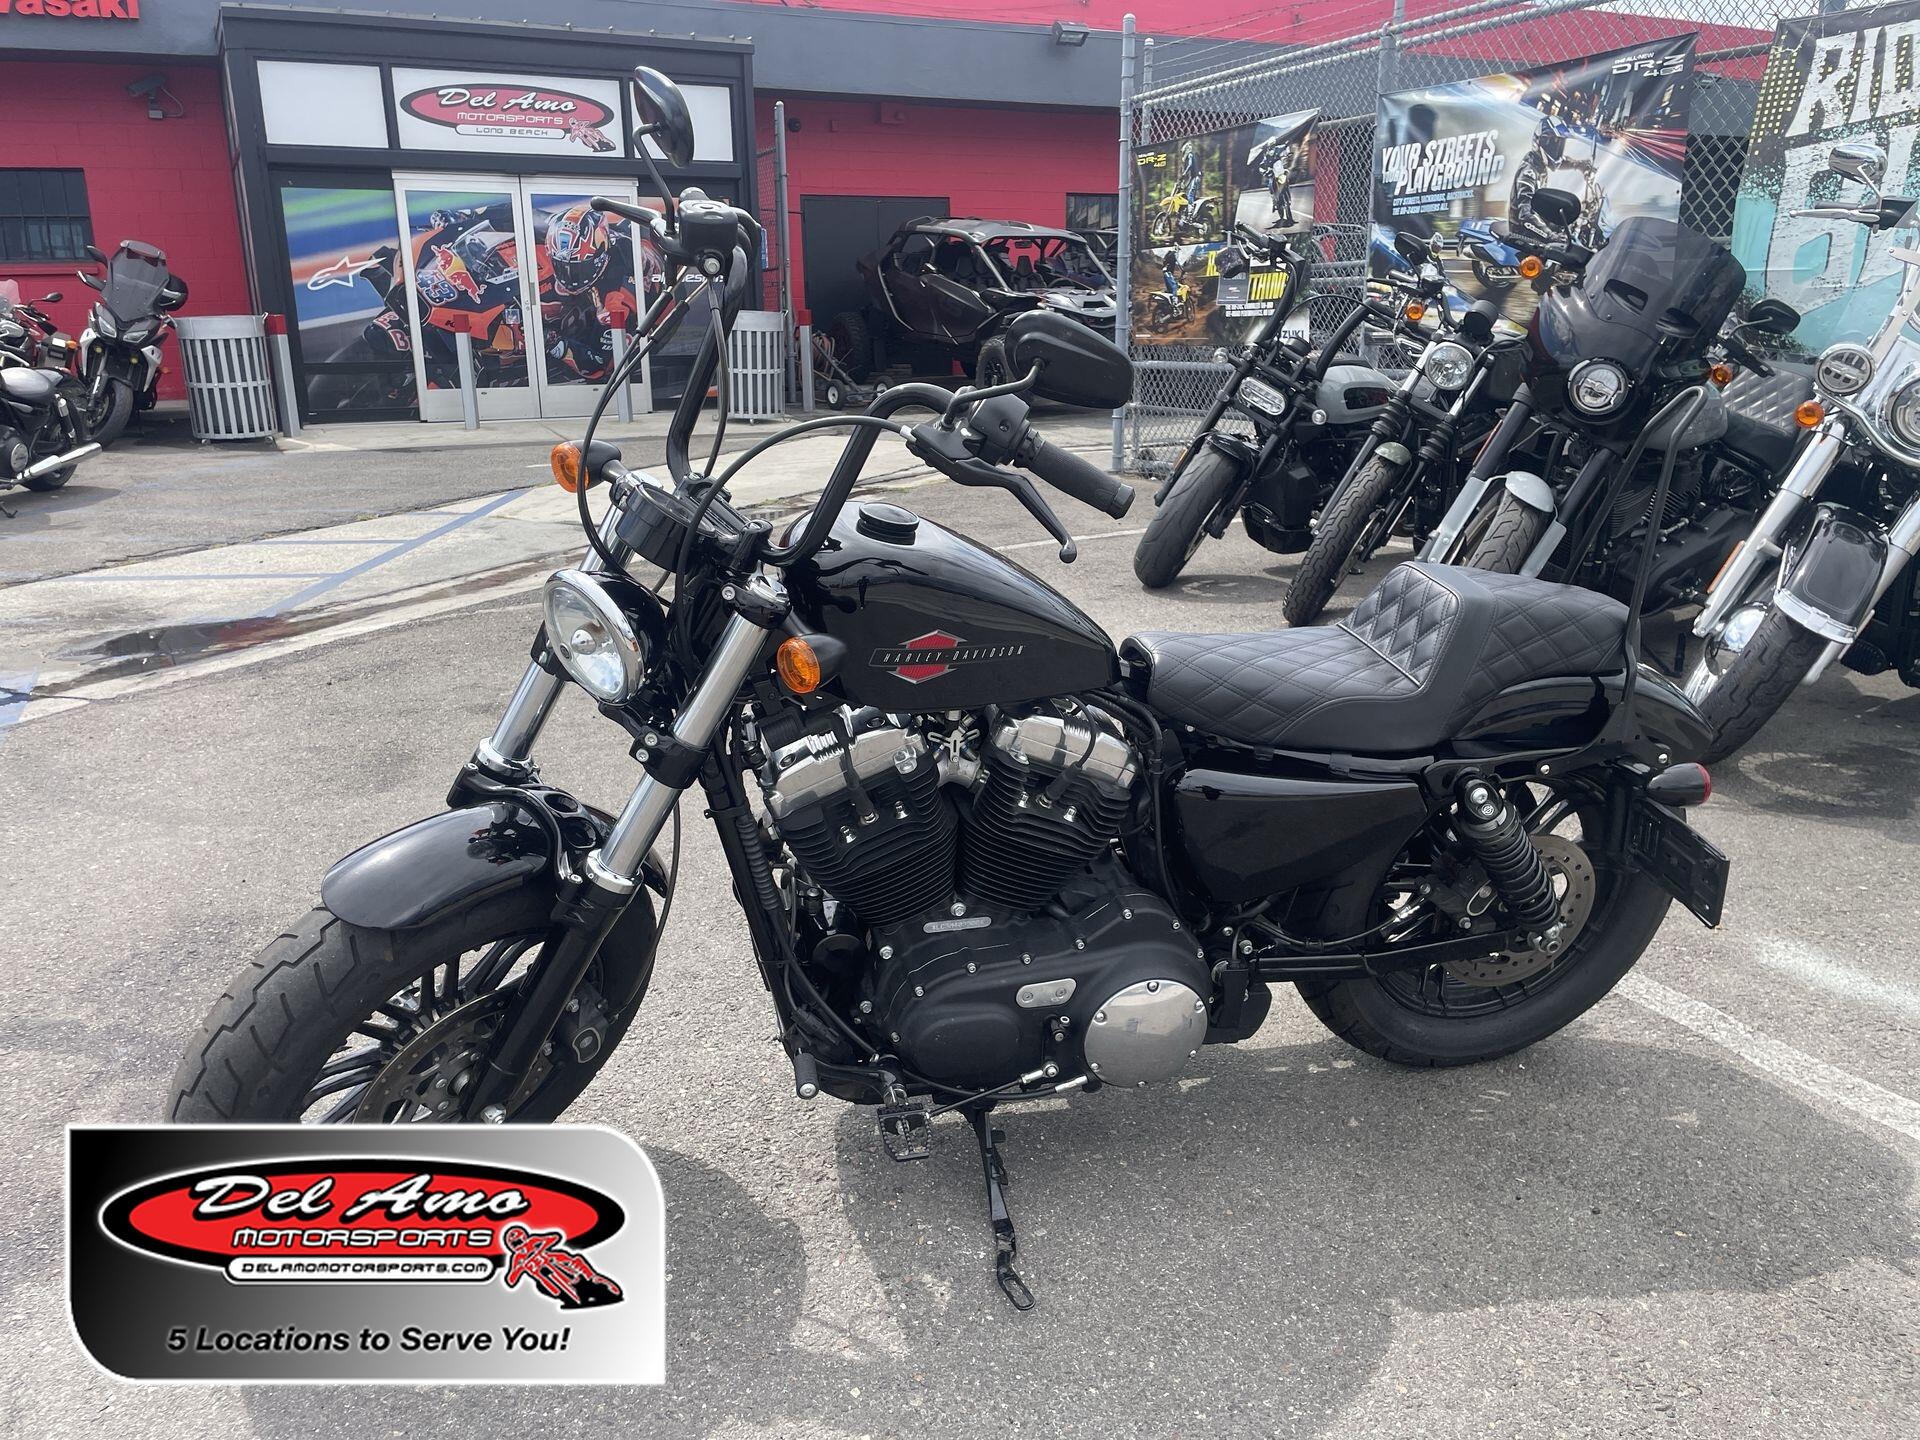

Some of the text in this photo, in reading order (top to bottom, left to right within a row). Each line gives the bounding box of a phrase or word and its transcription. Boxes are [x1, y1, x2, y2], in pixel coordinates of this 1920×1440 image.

[0, 0, 140, 19] asaki
[438, 88, 577, 112] Del Amo
[456, 112, 564, 125] MOTORSPORTS
[476, 127, 504, 135] LONG
[1382, 129, 1498, 173] YOUR STREETS
[1394, 154, 1505, 195] PLAYGROUND
[883, 645, 1023, 663] HARLEY-DAVIDSON
